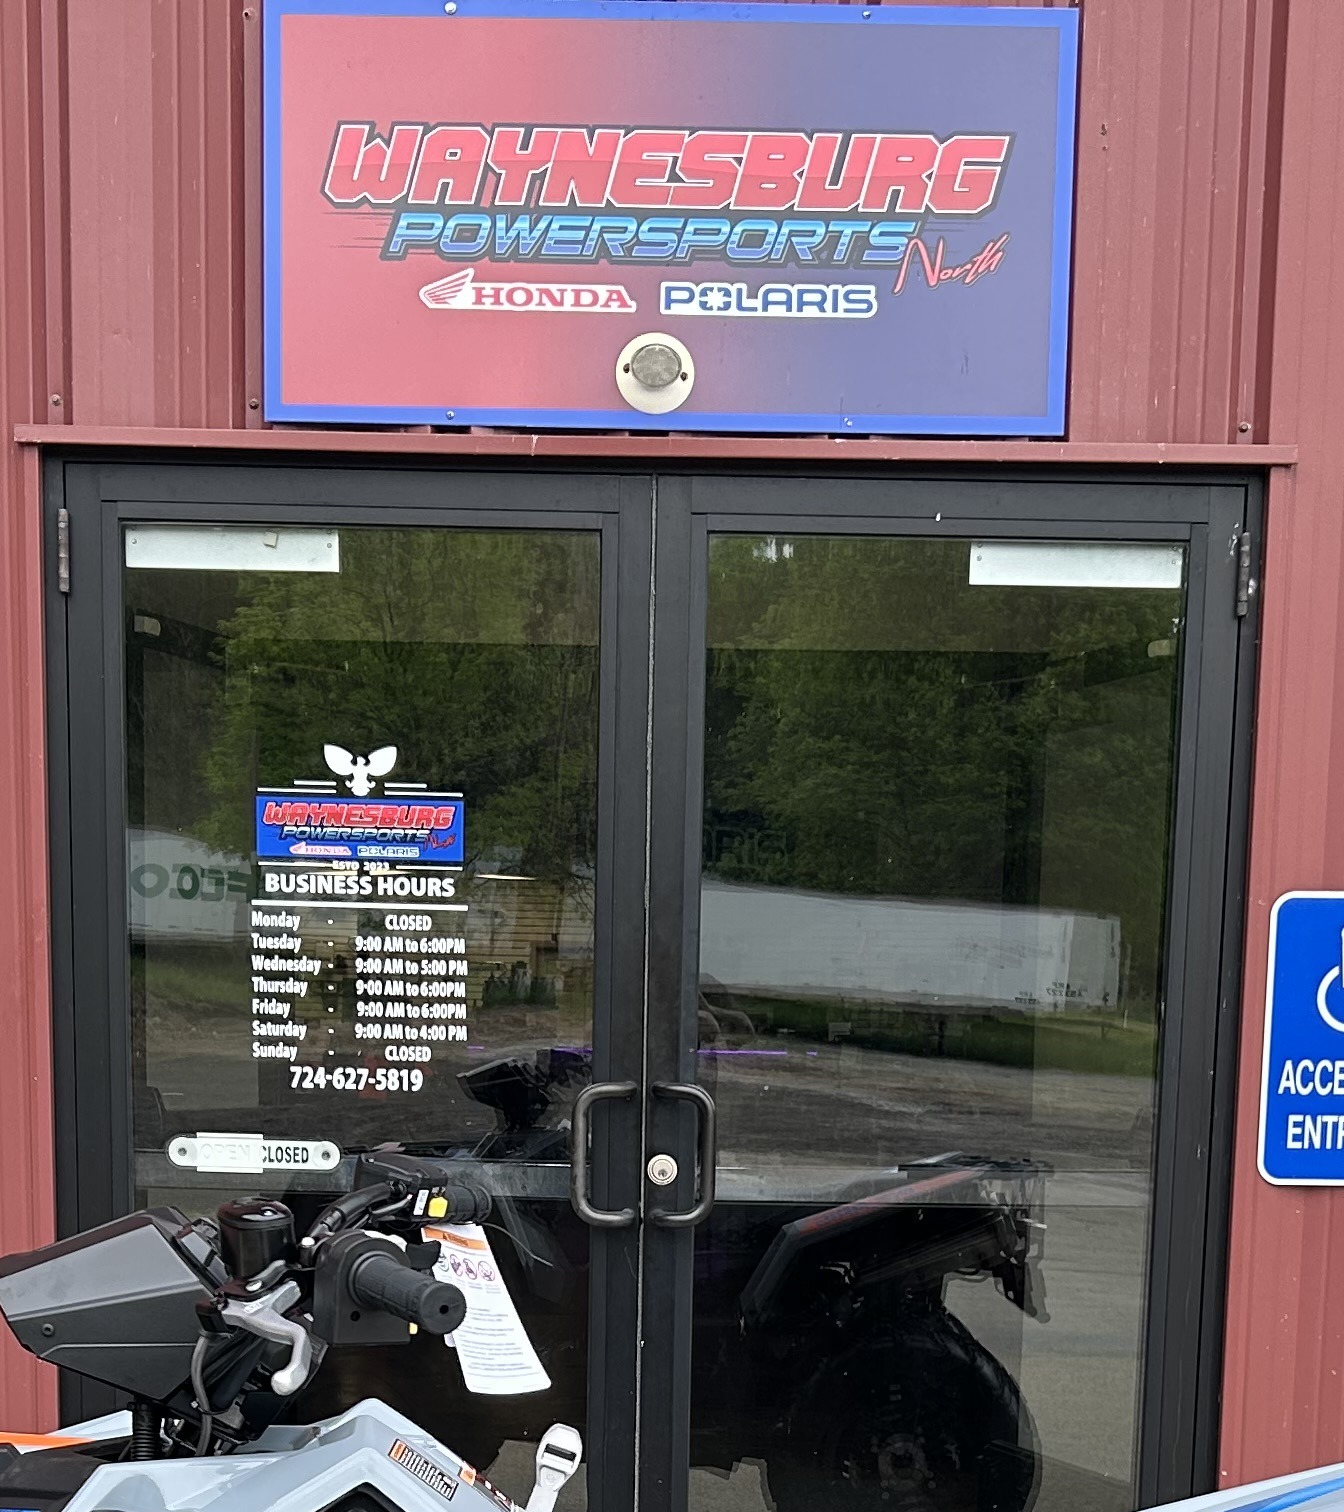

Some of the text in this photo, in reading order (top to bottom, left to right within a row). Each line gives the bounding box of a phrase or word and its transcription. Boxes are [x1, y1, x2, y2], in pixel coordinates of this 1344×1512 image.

[323, 123, 1012, 214] WAYNESBURG
[384, 211, 1009, 296] POWERSPORTS North
[471, 285, 632, 310] HONDA
[663, 284, 875, 316] POLARIS
[263, 801, 455, 829] WAYNESBURG
[281, 826, 431, 842] POWERSPORTS
[357, 847, 420, 857] POLARIS
[265, 873, 374, 896] BUSINESS
[377, 875, 456, 897] HOURS
[251, 911, 432, 931] Monday CLOSED
[251, 933, 302, 953] Tuesday
[355, 935, 382, 952] 9:00
[383, 936, 404, 953] AM
[405, 938, 419, 953] to
[251, 955, 469, 976] Wednesday 9:00 AM to 5:00 PM
[251, 976, 309, 997] Thursday
[383, 980, 405, 997] AM
[405, 981, 419, 997] to
[251, 998, 291, 1019] Friday
[356, 1001, 383, 1018] 9:00
[384, 1002, 405, 1018] AM
[406, 1003, 420, 1018] to
[251, 1020, 468, 1042] Saturday 9:00 AM to 4:00 PM
[251, 1042, 432, 1062] Sunday CLOSED
[289, 1065, 424, 1092] 724-627-5819
